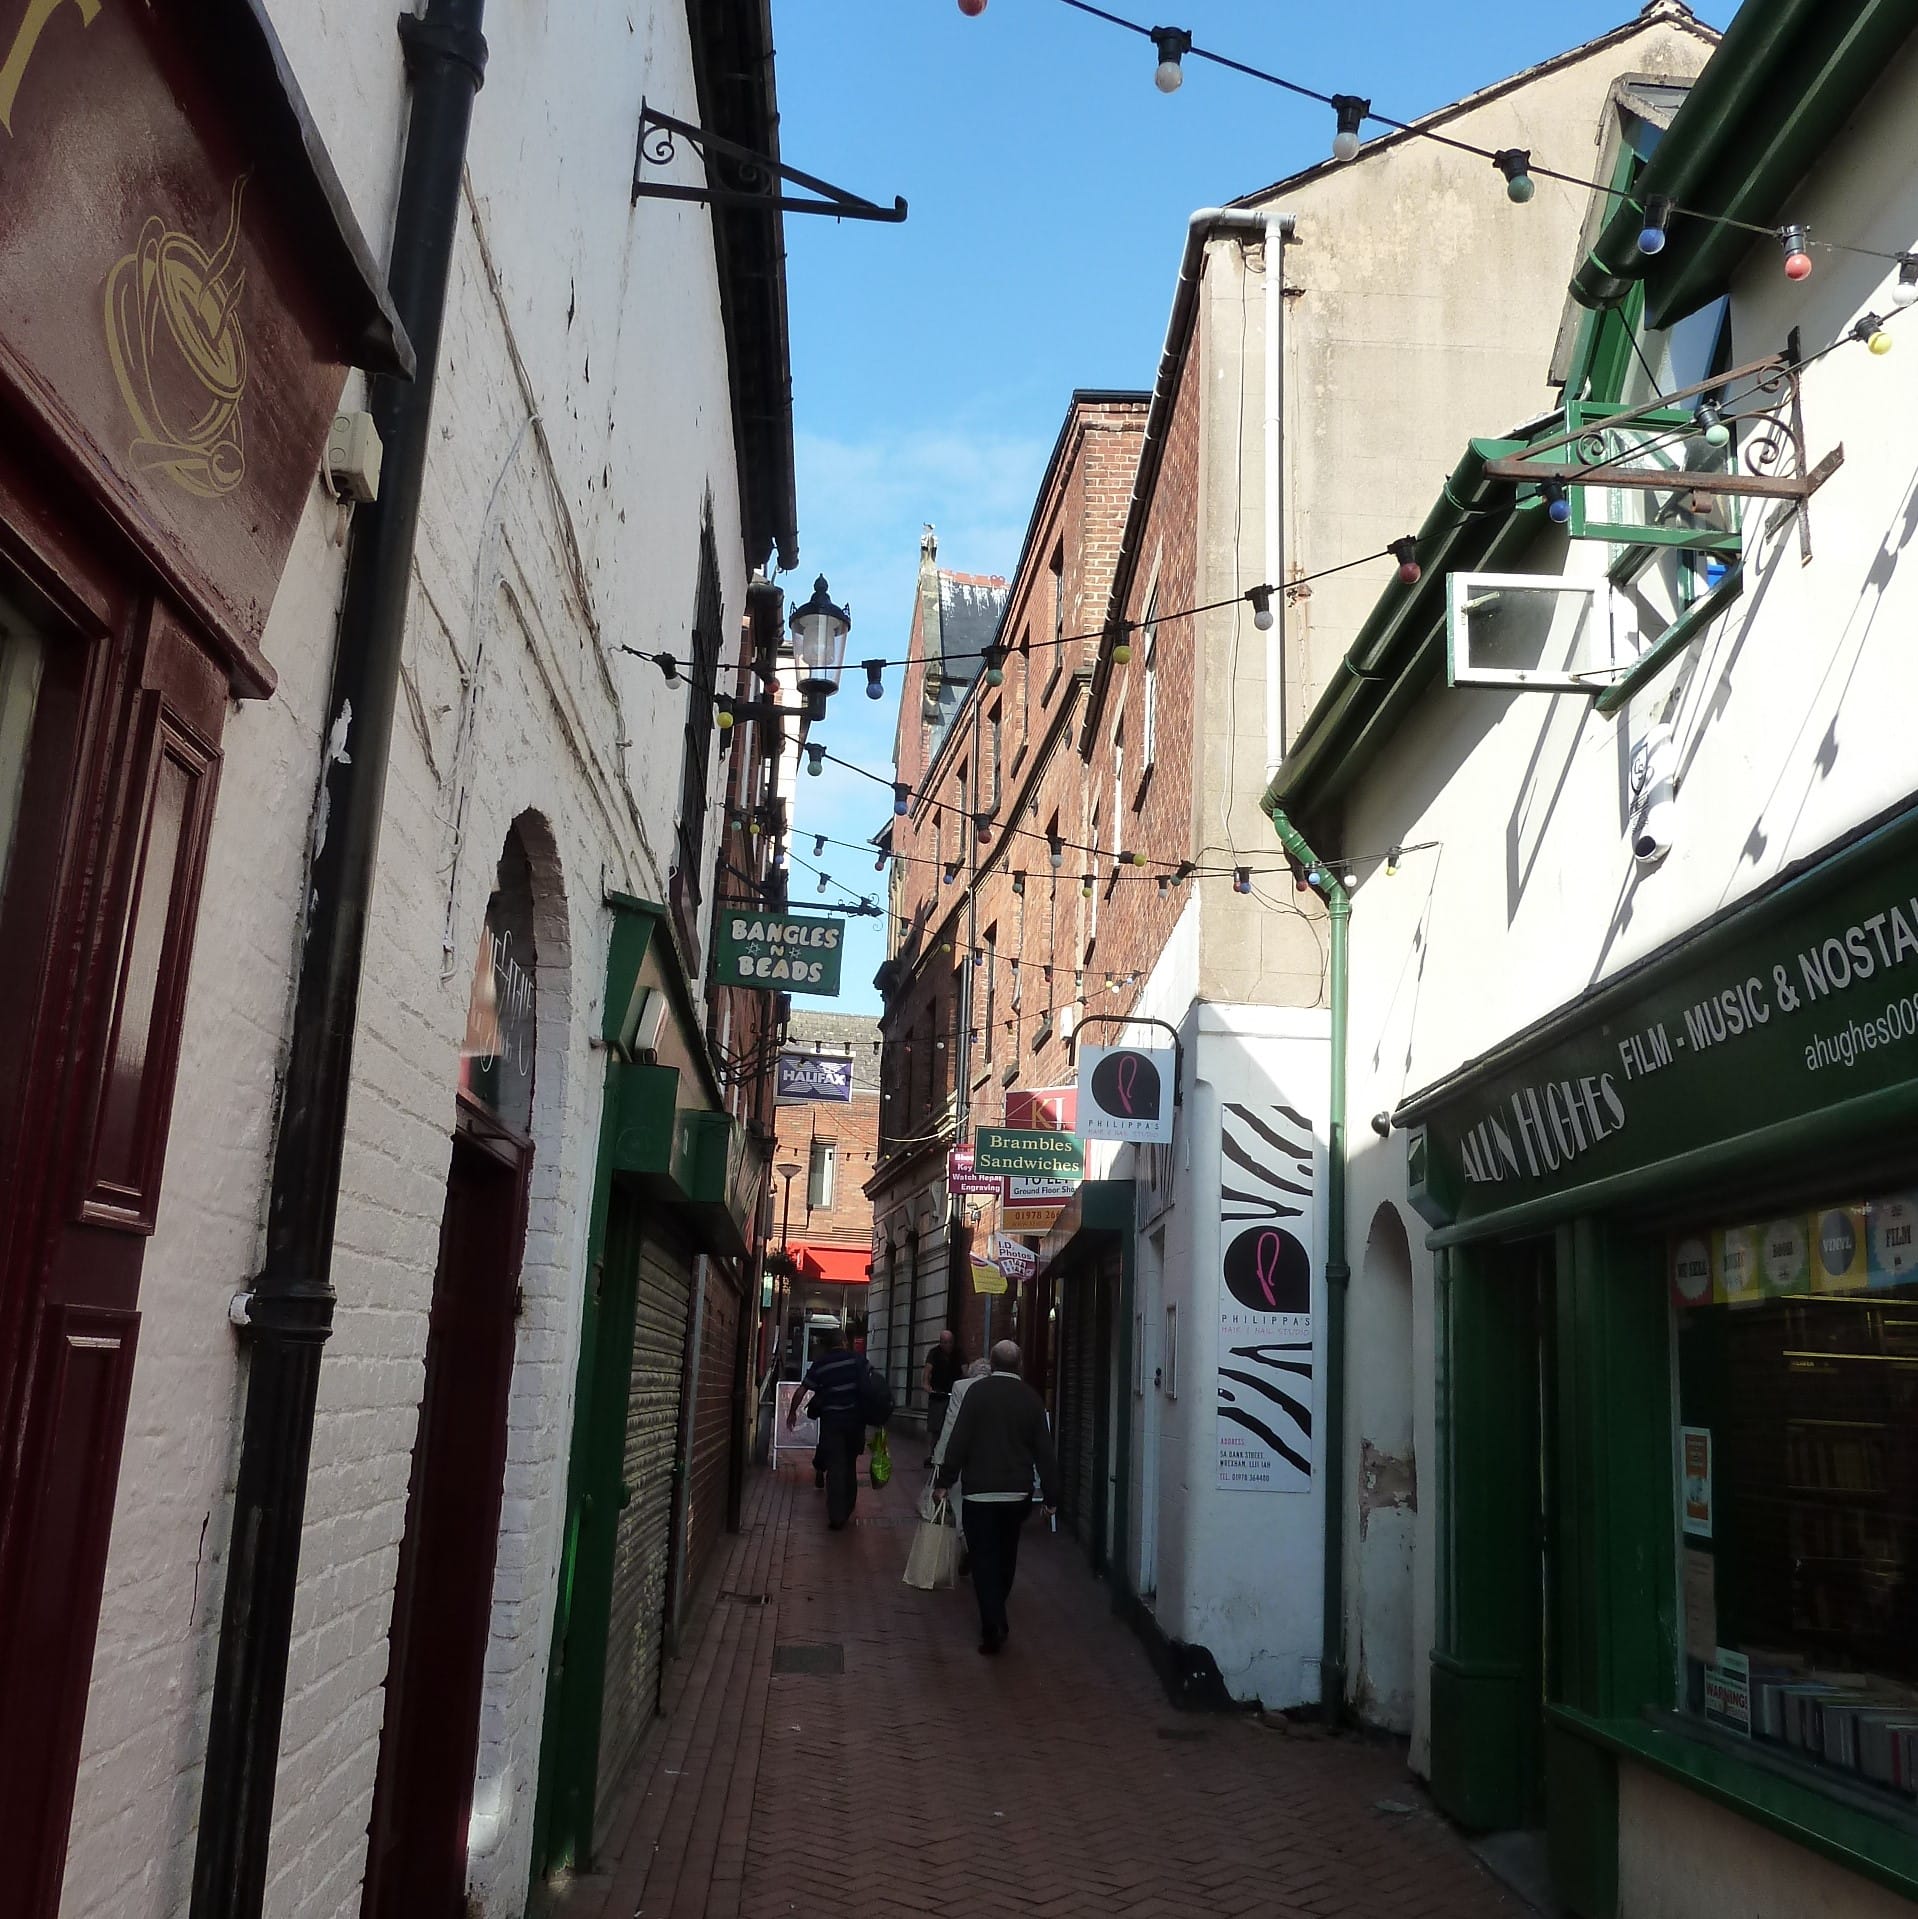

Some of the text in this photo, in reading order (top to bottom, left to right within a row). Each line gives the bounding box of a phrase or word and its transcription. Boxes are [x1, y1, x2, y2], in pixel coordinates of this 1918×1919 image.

[731, 919, 840, 949] BANGLES
[770, 944, 785, 957] N
[738, 955, 824, 983] BEADS
[1618, 1022, 1675, 1082] FILM
[1683, 977, 1770, 1052] MUSIC
[1772, 964, 1801, 1013] &
[783, 1069, 846, 1086] HALIFAX
[1461, 1072, 1626, 1183] ALUN HUGHES
[990, 1135, 1072, 1152] Brambles
[957, 1163, 973, 1172] Key
[980, 1154, 1080, 1172] Sandwiches
[952, 1173, 977, 1181] Watch
[961, 1183, 1001, 1193] Engraving
[1013, 1185, 1076, 1196] Ground Floor Sho
[1015, 1211, 1042, 1220] 01978
[1887, 1224, 1912, 1248] FILM
[999, 1248, 1032, 1260] Photos
[1706, 1684, 1748, 1709] WARNING!
